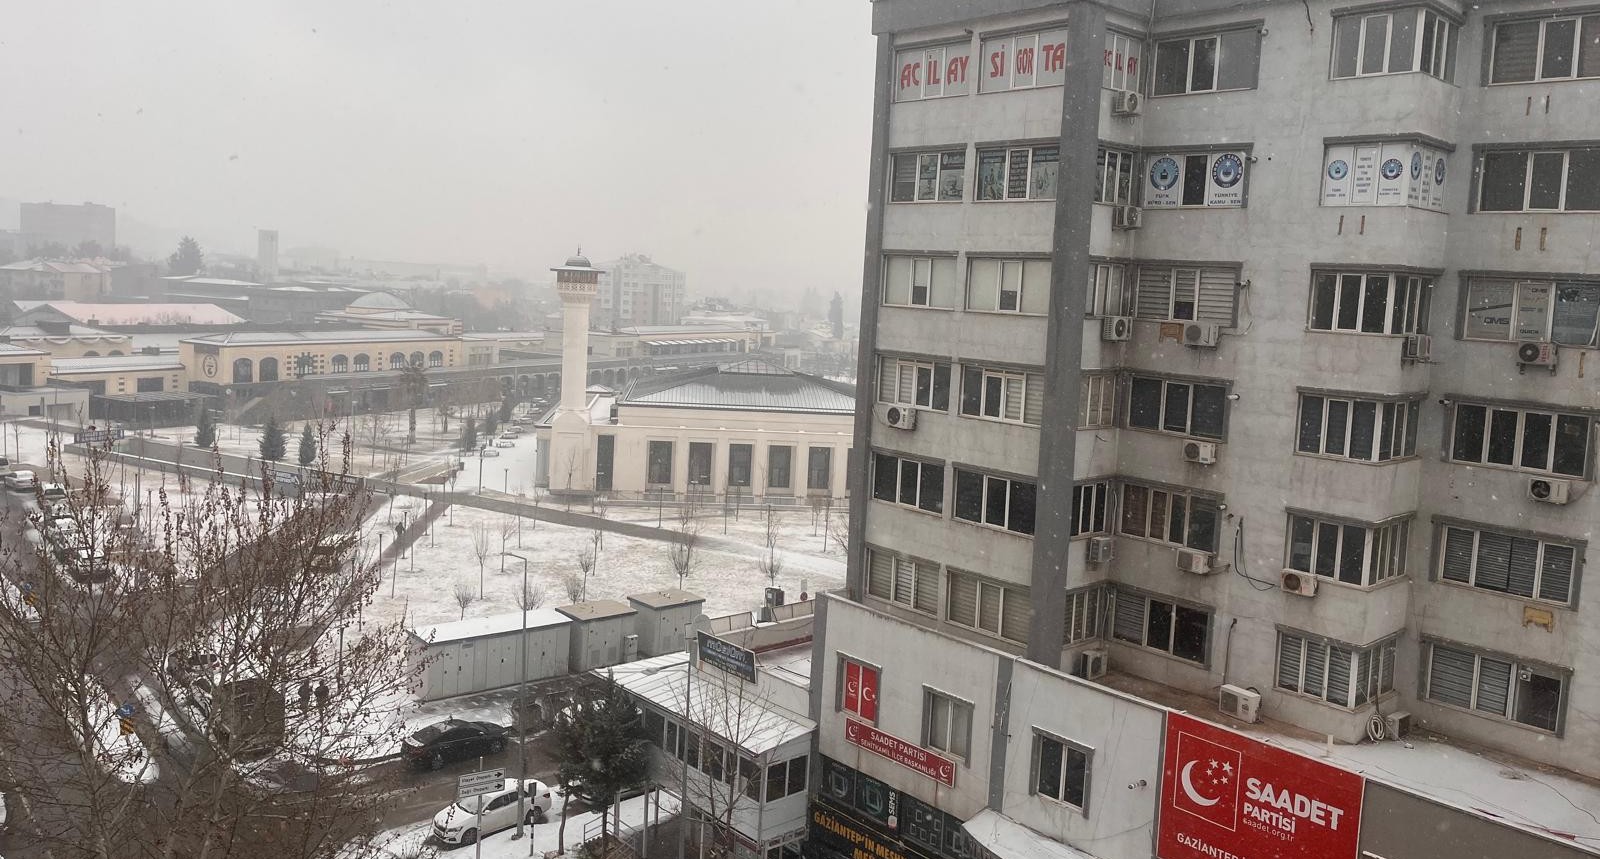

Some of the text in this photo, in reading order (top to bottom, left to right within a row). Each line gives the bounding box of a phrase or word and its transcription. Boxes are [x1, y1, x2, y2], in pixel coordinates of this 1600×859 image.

[870, 731, 927, 762] SAADET PARTİSİ
[1243, 801, 1296, 834] PARTİSİ
[1245, 777, 1344, 831] SAADET
[1242, 817, 1295, 843] saadet.org.tr
